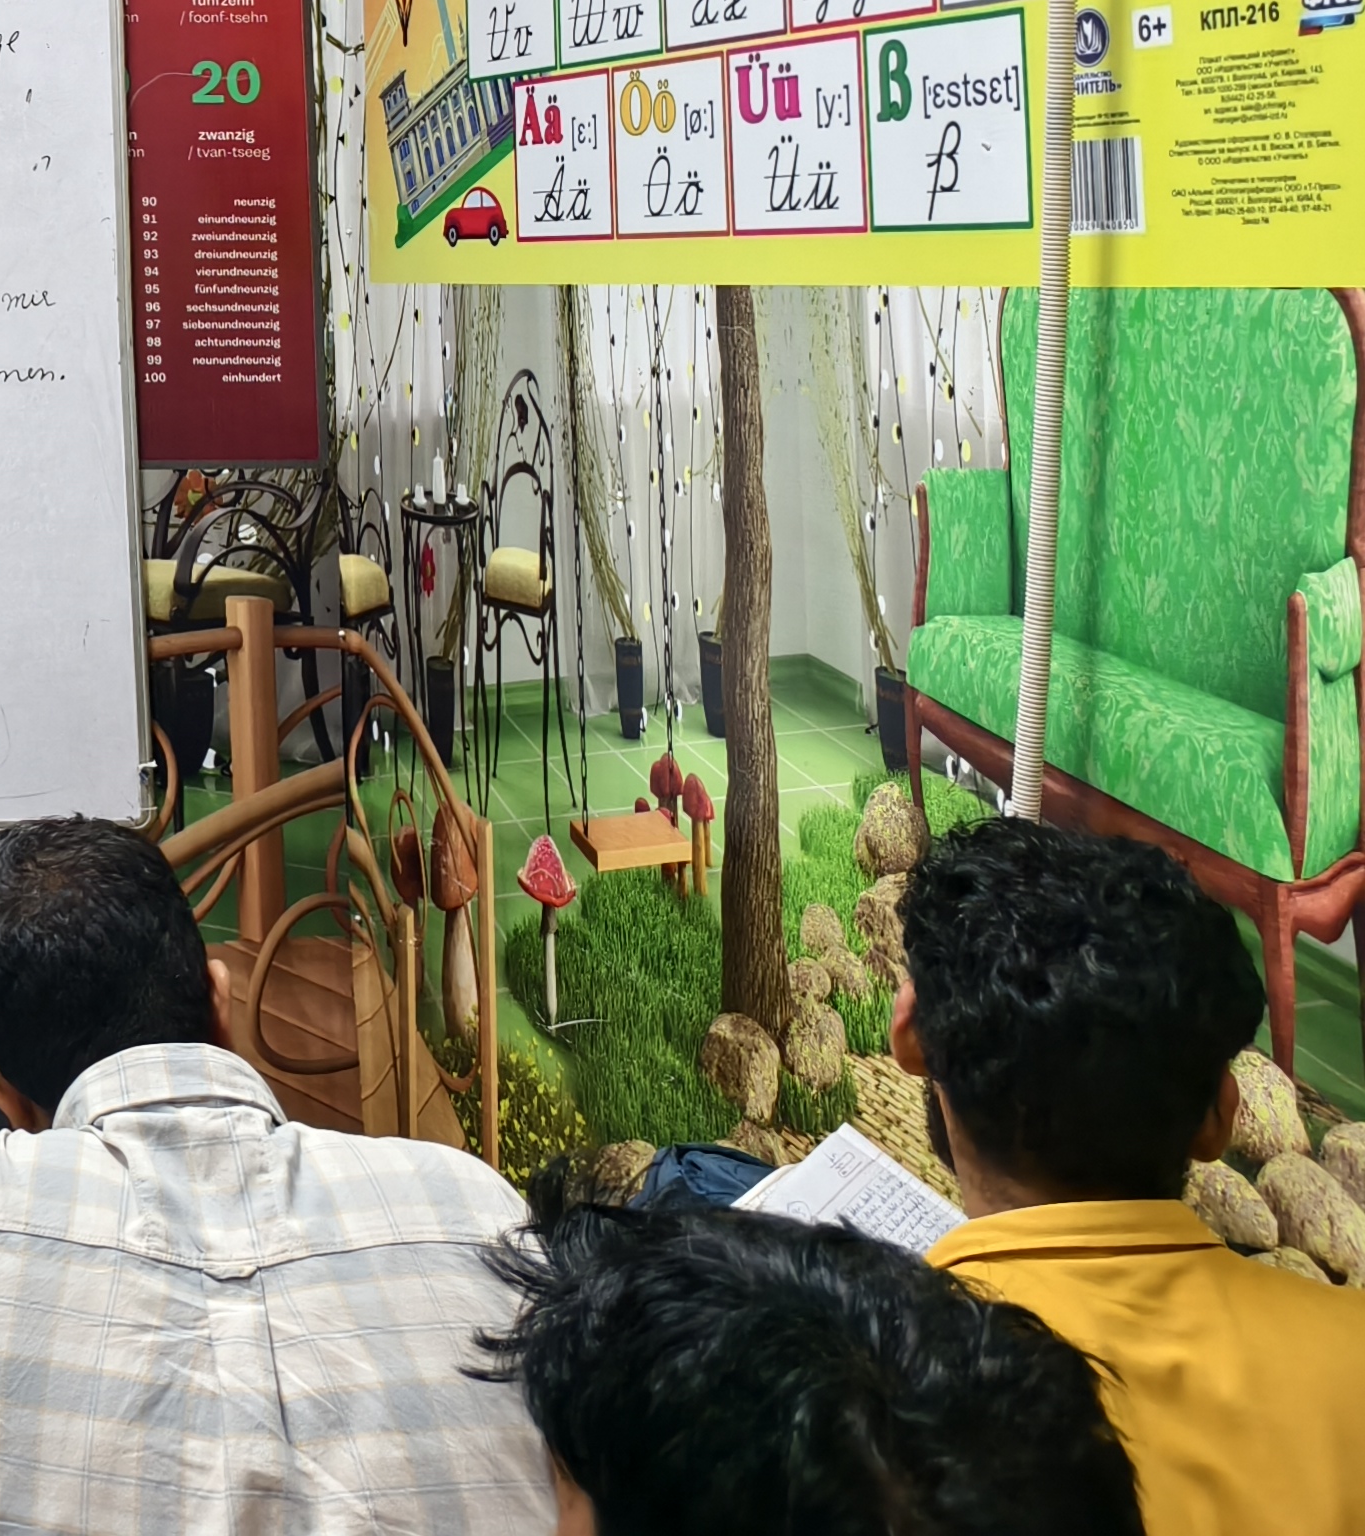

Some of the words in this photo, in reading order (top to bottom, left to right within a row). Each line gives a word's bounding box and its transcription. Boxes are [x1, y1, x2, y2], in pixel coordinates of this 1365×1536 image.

[1138, 14, 1166, 42] 6+
[1200, 1, 1280, 31] КПЛ-216
[192, 61, 261, 104] 20
[735, 53, 801, 125] Üü
[519, 86, 563, 147] Ää
[198, 128, 254, 143] zwanzig
[142, 214, 157, 224] 91
[198, 214, 276, 225] einundneunzig
[146, 337, 161, 346] 98
[195, 337, 281, 349] achtundneunzig
[144, 373, 166, 382] 100
[222, 373, 281, 382] einhundert
